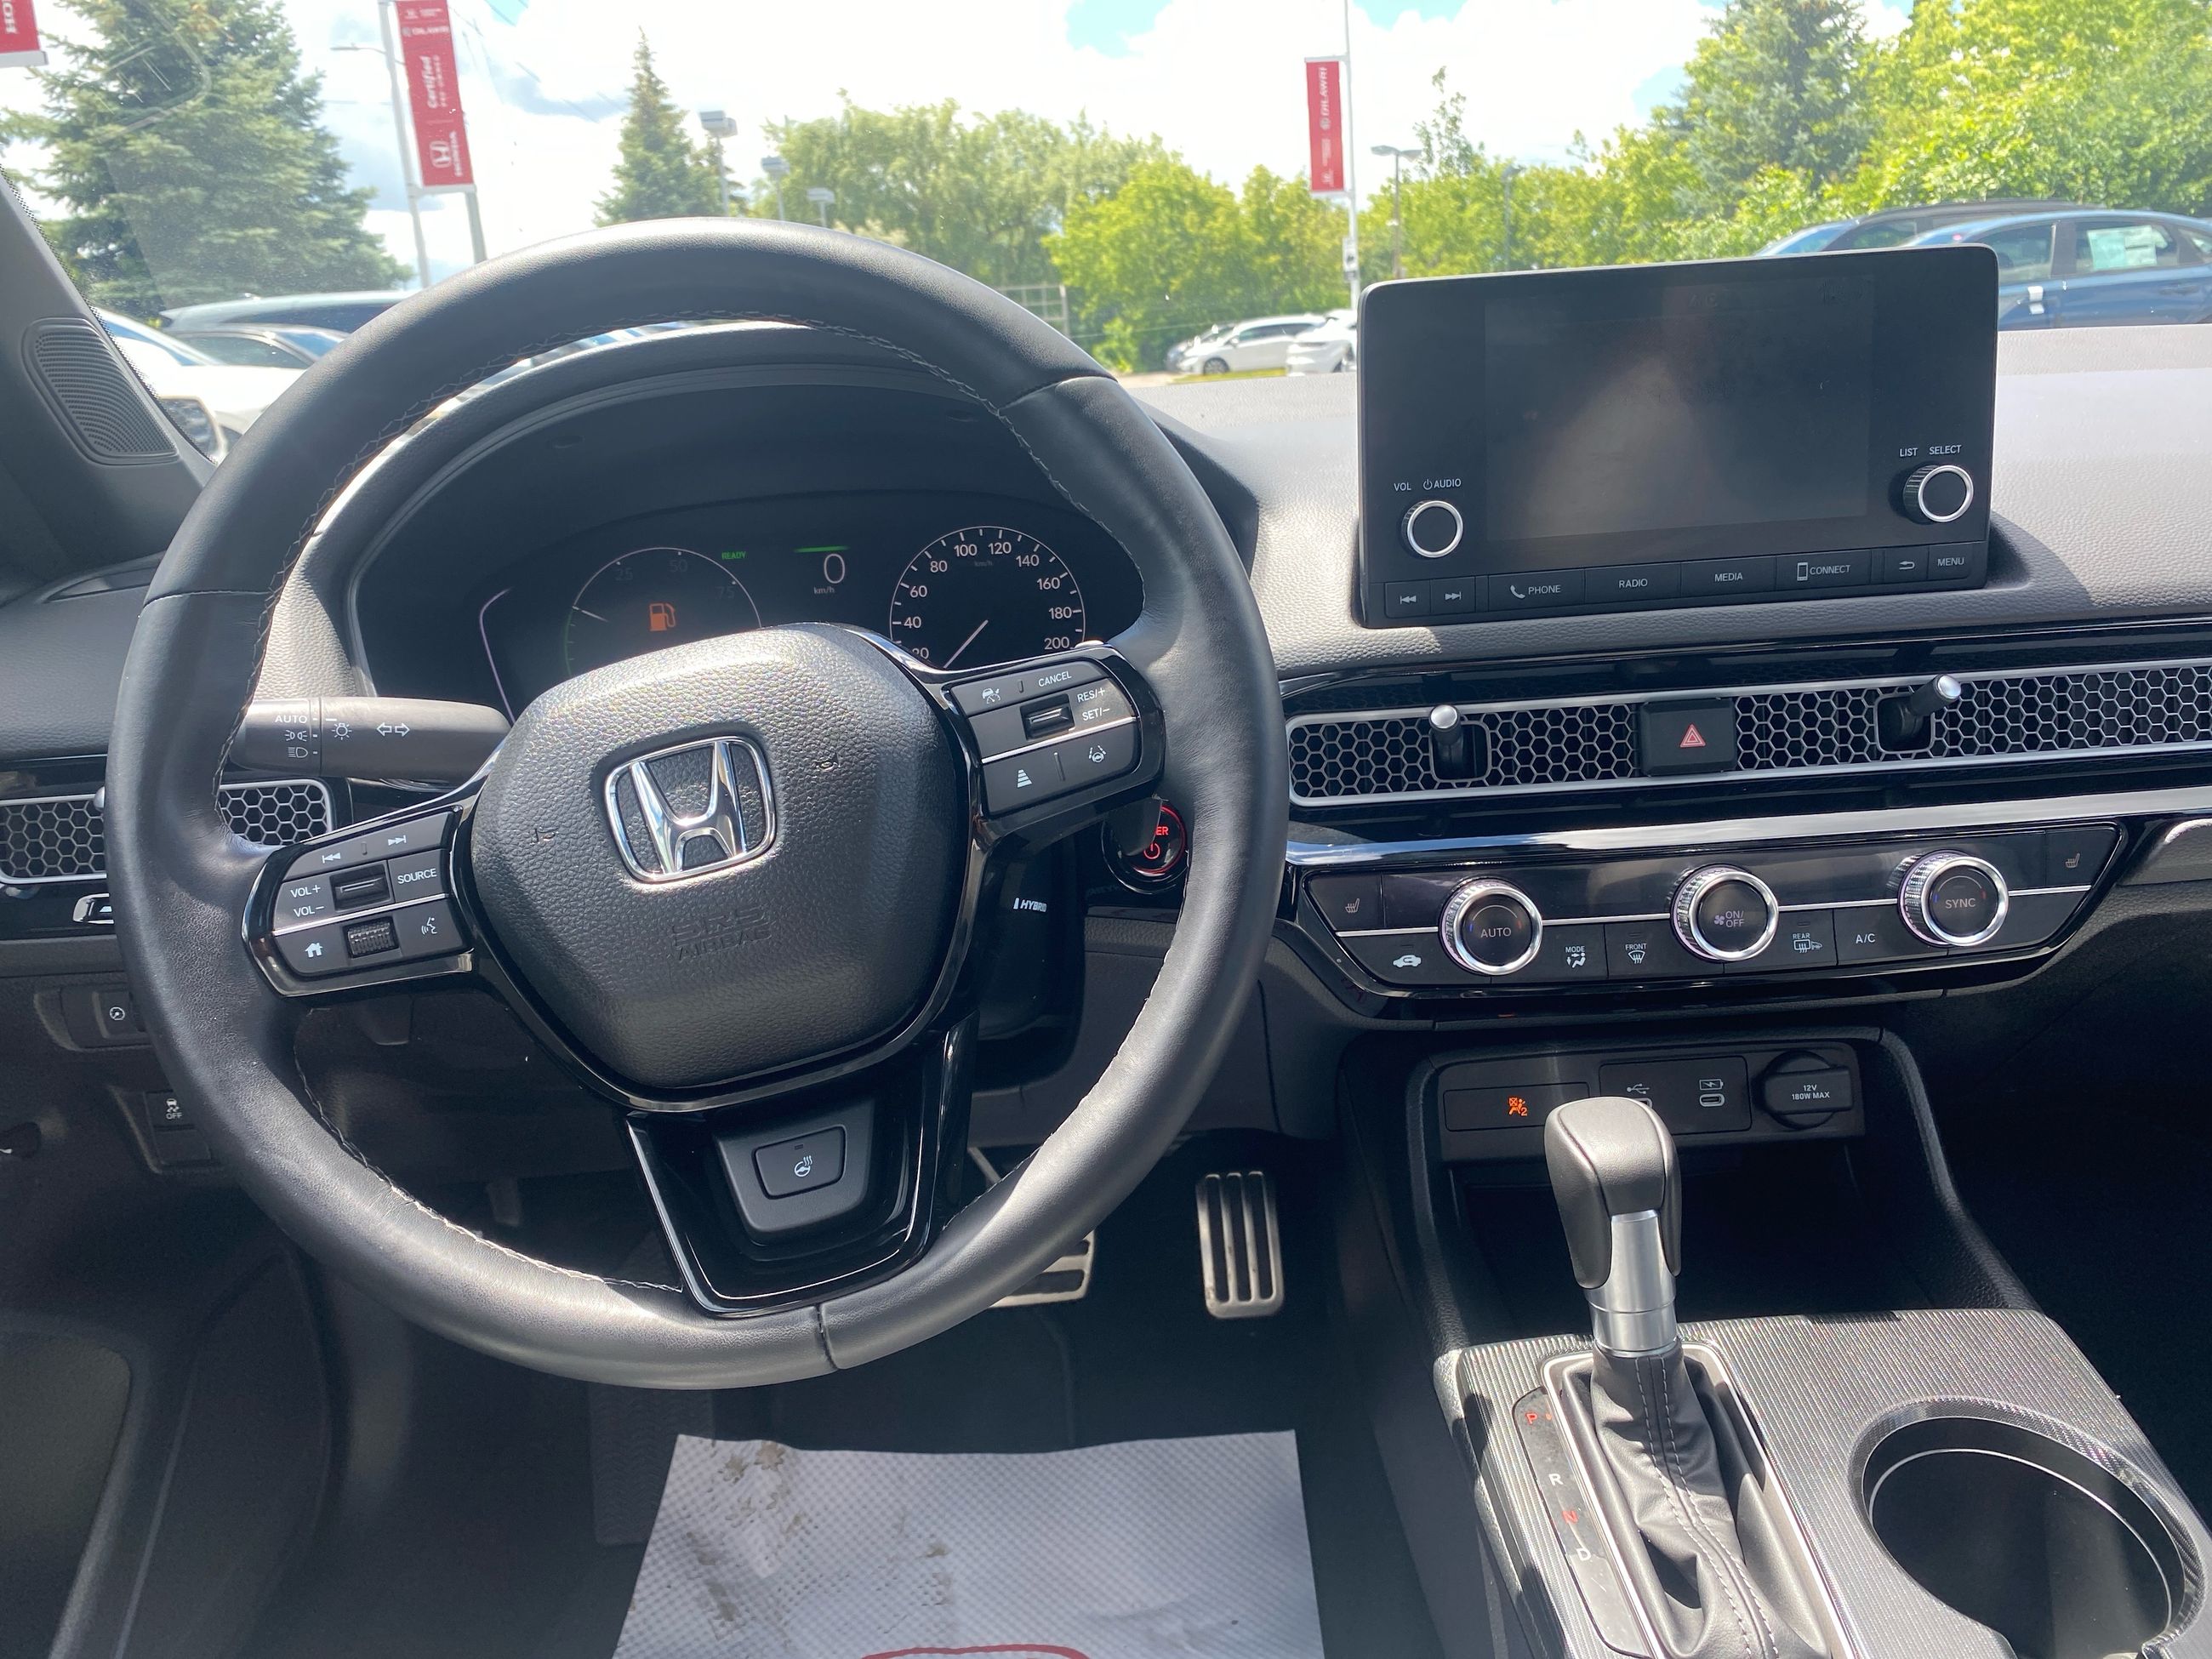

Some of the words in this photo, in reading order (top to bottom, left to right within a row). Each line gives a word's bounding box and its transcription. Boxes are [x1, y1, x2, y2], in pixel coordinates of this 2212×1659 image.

[3, 0, 19, 34] HO
[1899, 447, 1918, 457] LIST
[1929, 444, 1962, 455] SELECT
[1393, 482, 1412, 492] VOL
[1434, 478, 1462, 489] AUDIO
[954, 543, 978, 557] 100
[988, 541, 1012, 555] 120
[721, 551, 746, 560] READY
[1016, 554, 1040, 567] 140
[1937, 556, 1965, 567] MENU
[824, 553, 846, 584] 0
[930, 560, 948, 573] 80
[1810, 564, 1851, 575] CONNECT
[1036, 577, 1060, 590] 160
[1714, 572, 1743, 583] MEDIA
[1528, 584, 1561, 595] PHONE
[1618, 579, 1648, 589] RADIO
[813, 586, 835, 595] km/h
[909, 585, 927, 598] 60
[1048, 606, 1072, 620] 180
[904, 616, 921, 629] 40
[1044, 636, 1069, 650] 200
[1038, 670, 1072, 687] CANCEL
[1077, 687, 1106, 704] RES/+
[274, 715, 308, 724] AUTO
[1154, 825, 1170, 836] ER
[396, 868, 437, 885] SOURCE
[1020, 899, 1047, 913] HYBRID
[1945, 898, 1976, 909] SYNC
[1725, 910, 1744, 919] ON/
[1725, 919, 1744, 928] OFF
[1480, 926, 1512, 938] AUTO
[1856, 933, 1876, 944] A/C
[1812, 1091, 1830, 1099] MAX
[1520, 1107, 1528, 1116] 2
[1525, 1411, 1538, 1424] P
[1548, 1473, 1564, 1486] R
[1562, 1510, 1578, 1524] N
[1576, 1548, 1592, 1561] D
